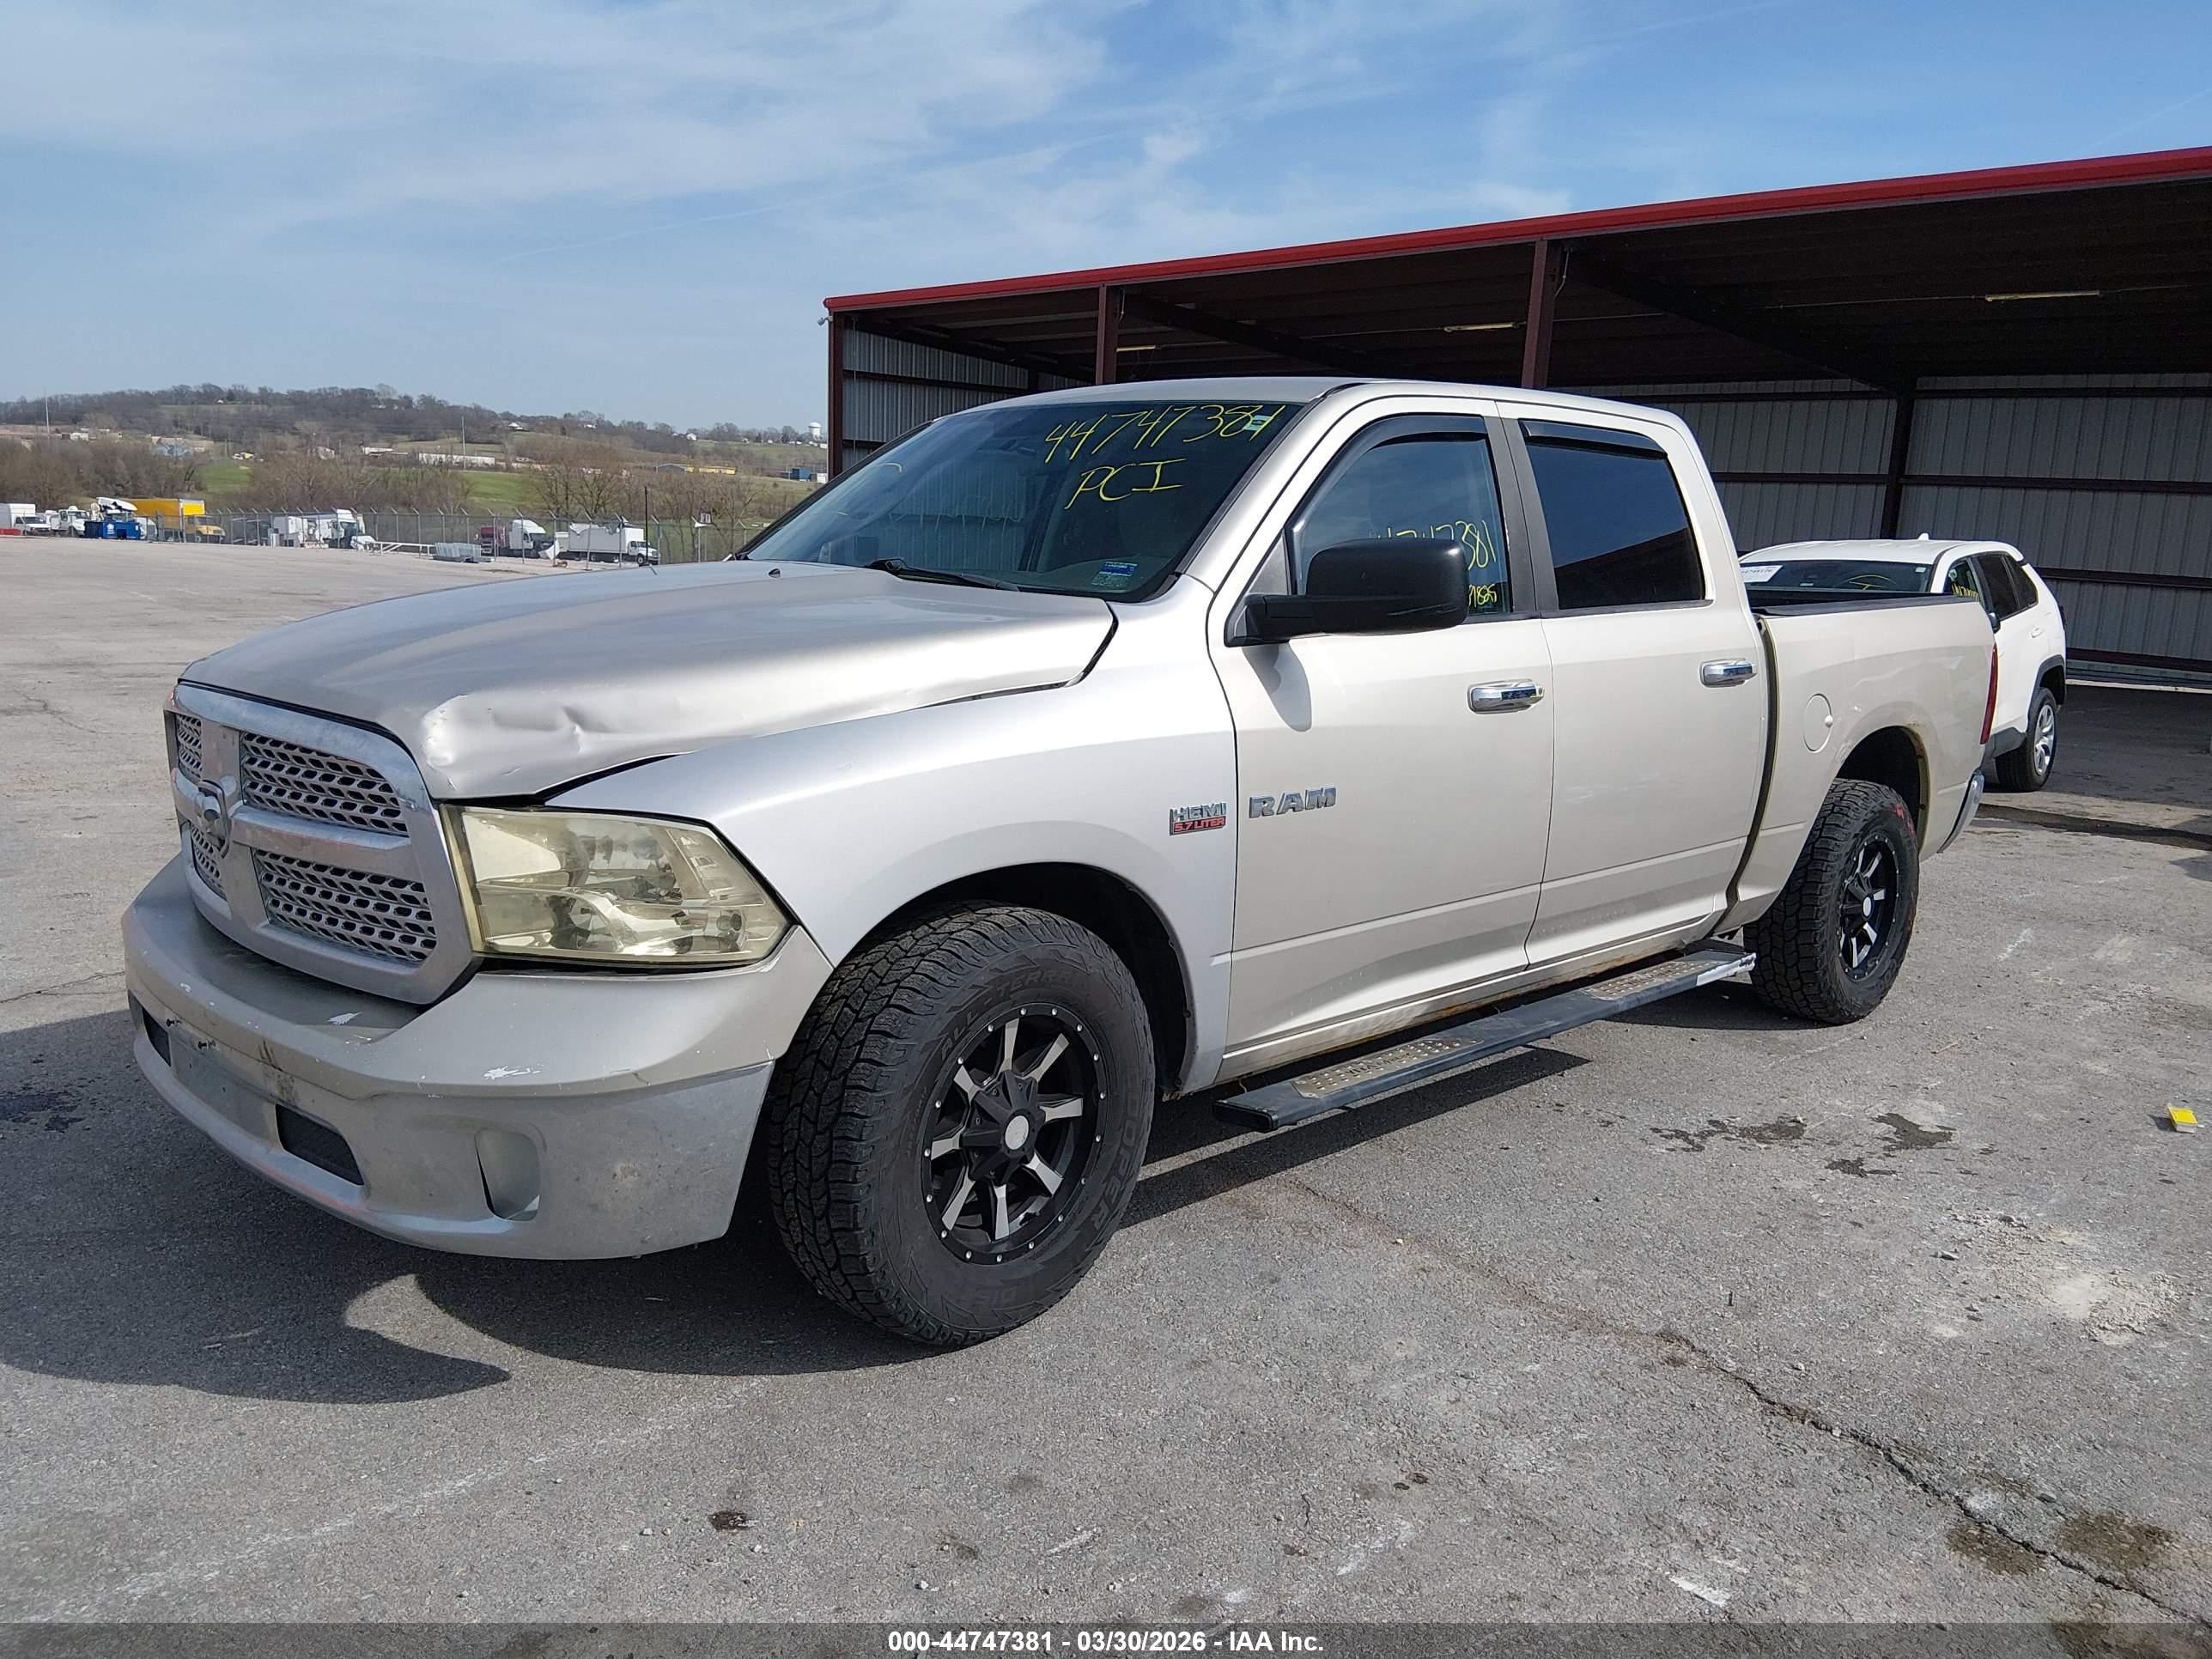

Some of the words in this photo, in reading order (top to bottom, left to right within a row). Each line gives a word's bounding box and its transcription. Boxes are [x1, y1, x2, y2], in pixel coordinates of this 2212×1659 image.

[1064, 458, 1187, 509] PCI
[1169, 800, 1227, 822] HEMI
[1249, 785, 1337, 818] RAM
[1174, 822, 1194, 832] 5.7
[1194, 817, 1224, 830] LITER
